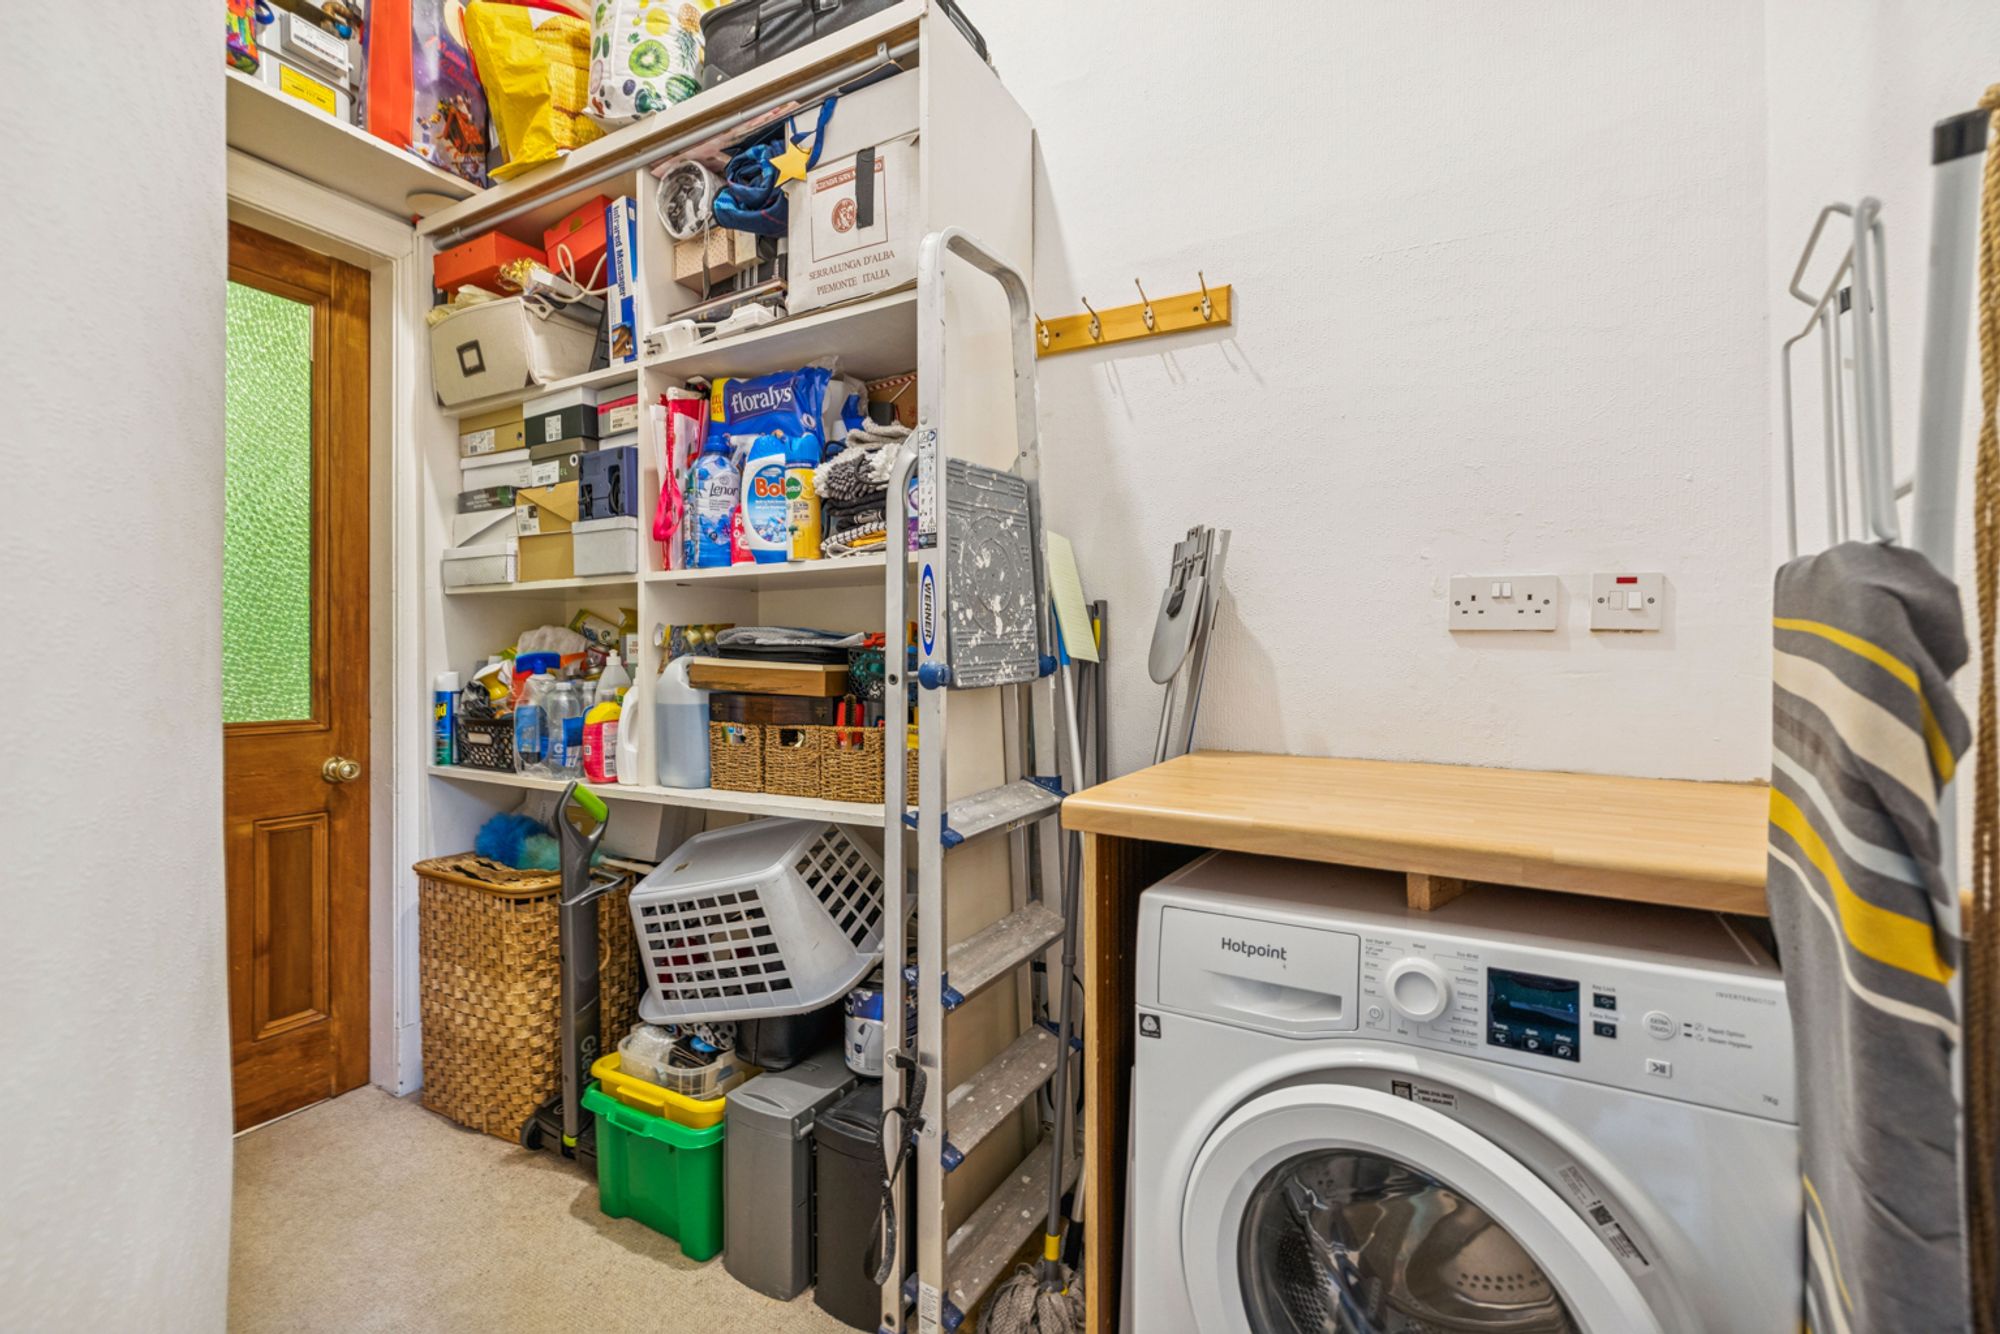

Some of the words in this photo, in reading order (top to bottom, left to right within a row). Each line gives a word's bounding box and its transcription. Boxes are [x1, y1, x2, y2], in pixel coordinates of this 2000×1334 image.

[613, 205, 623, 248] Infrared
[616, 248, 627, 297] Massager
[809, 259, 862, 281] SERRALUNGA
[863, 250, 895, 265] D'ALBA
[816, 277, 857, 296] PIEMONTE
[862, 269, 890, 283] ITALIA
[731, 385, 792, 414] floralys
[709, 482, 739, 497] Lenor
[755, 477, 786, 497] Bol
[924, 582, 932, 638] WERNER
[1221, 936, 1288, 961] Hotpoint
[581, 1034, 597, 1085] Gte
